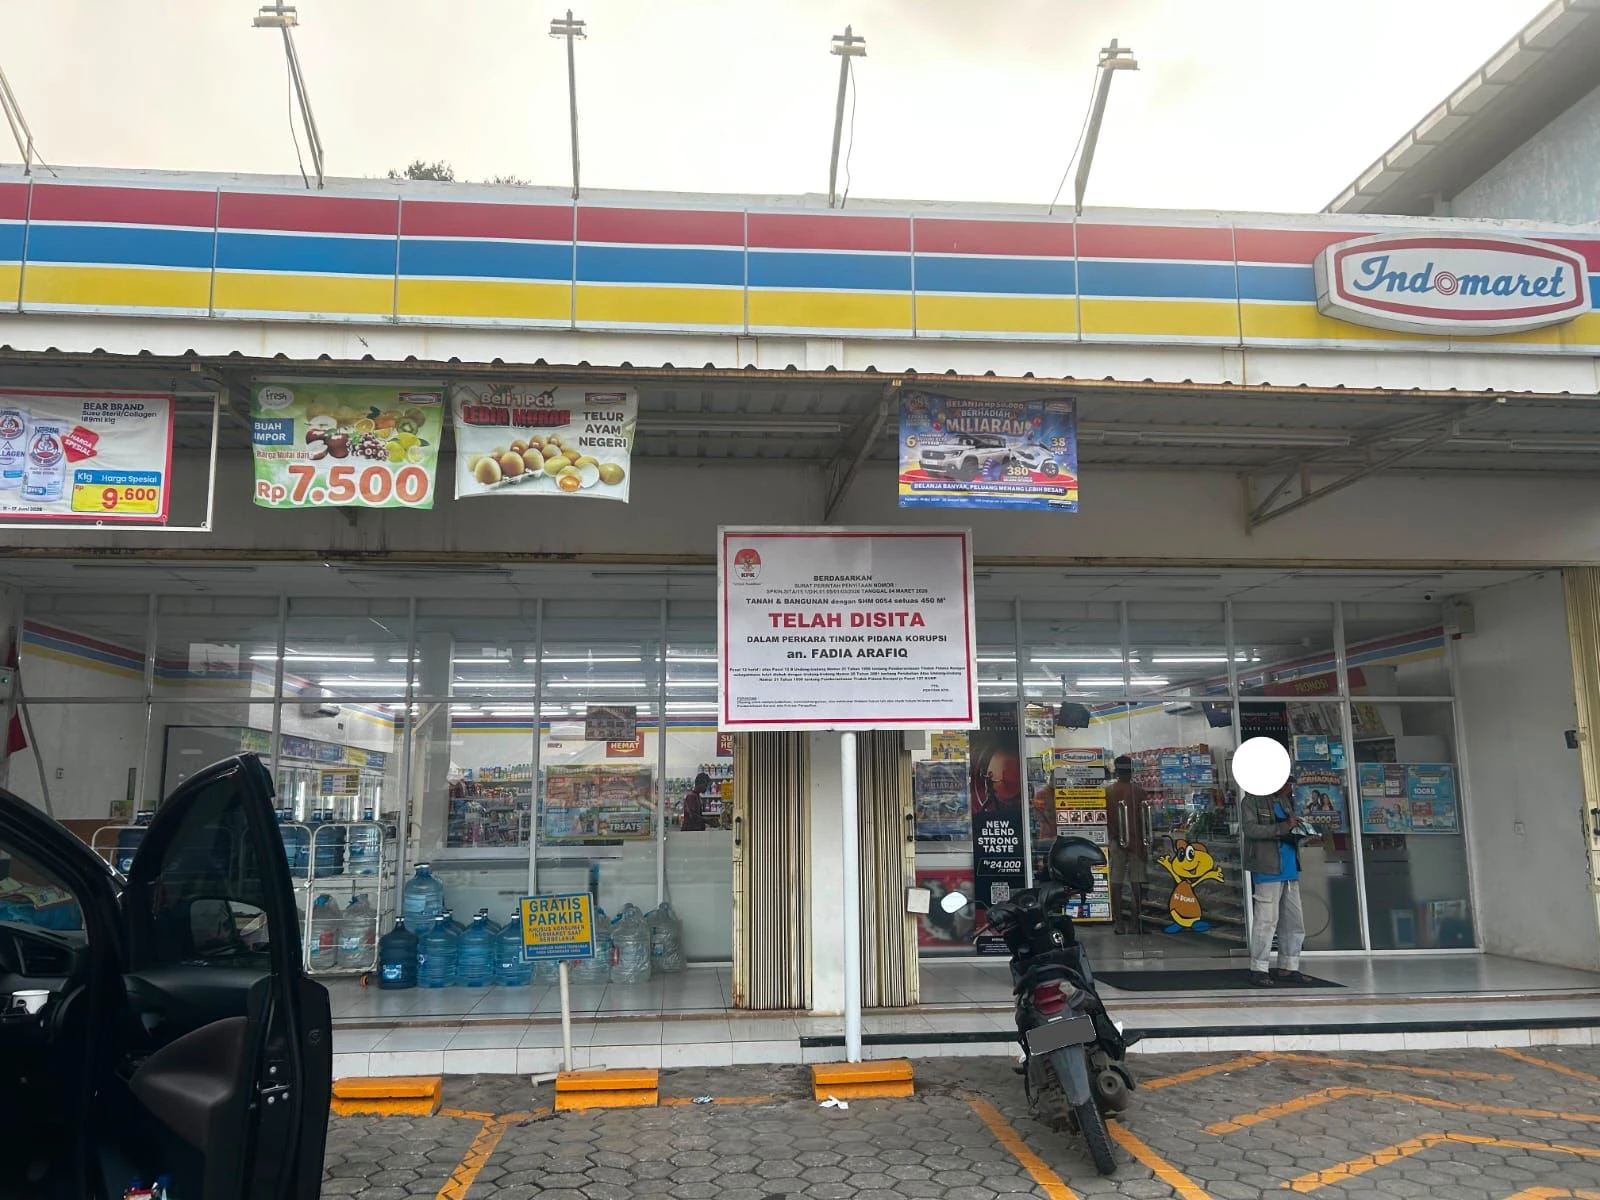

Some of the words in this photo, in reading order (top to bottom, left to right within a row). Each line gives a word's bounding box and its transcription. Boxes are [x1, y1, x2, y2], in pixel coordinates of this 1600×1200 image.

[1353, 255, 1566, 297] Indomaret
[526, 394, 553, 408] Pck
[84, 402, 109, 410] BEAR
[111, 403, 144, 411] BRAND
[583, 412, 624, 422] TELUR
[961, 408, 1010, 418] BERHADIAH
[254, 422, 282, 430] BUAH
[585, 425, 621, 434] AYAM
[946, 418, 1024, 434] MILIARAN
[254, 433, 286, 441] IMPOR
[579, 437, 627, 447] NEGERI
[1051, 437, 1066, 447] 38
[1007, 466, 1029, 476] 380
[77, 473, 93, 481] Klg
[102, 475, 125, 483] Harga
[128, 476, 157, 484] Spesial
[257, 481, 285, 502] Rp
[288, 465, 429, 503] 7.500
[102, 487, 157, 509] 9.600
[768, 612, 842, 628] TELAH
[850, 612, 925, 628] DISITA
[867, 635, 902, 643] PIDANA
[786, 650, 807, 658] an.
[811, 648, 853, 658] FADIA
[856, 648, 908, 659] ARAFIQ
[610, 823, 641, 831] TREATS
[986, 820, 1009, 828] NEW
[981, 828, 1015, 836] BLEND
[977, 837, 1018, 845] STRONG
[983, 845, 1014, 853] TASTE
[990, 860, 1021, 869] 24.000
[529, 897, 581, 912] GRATIS
[528, 911, 583, 926] PARKIR
